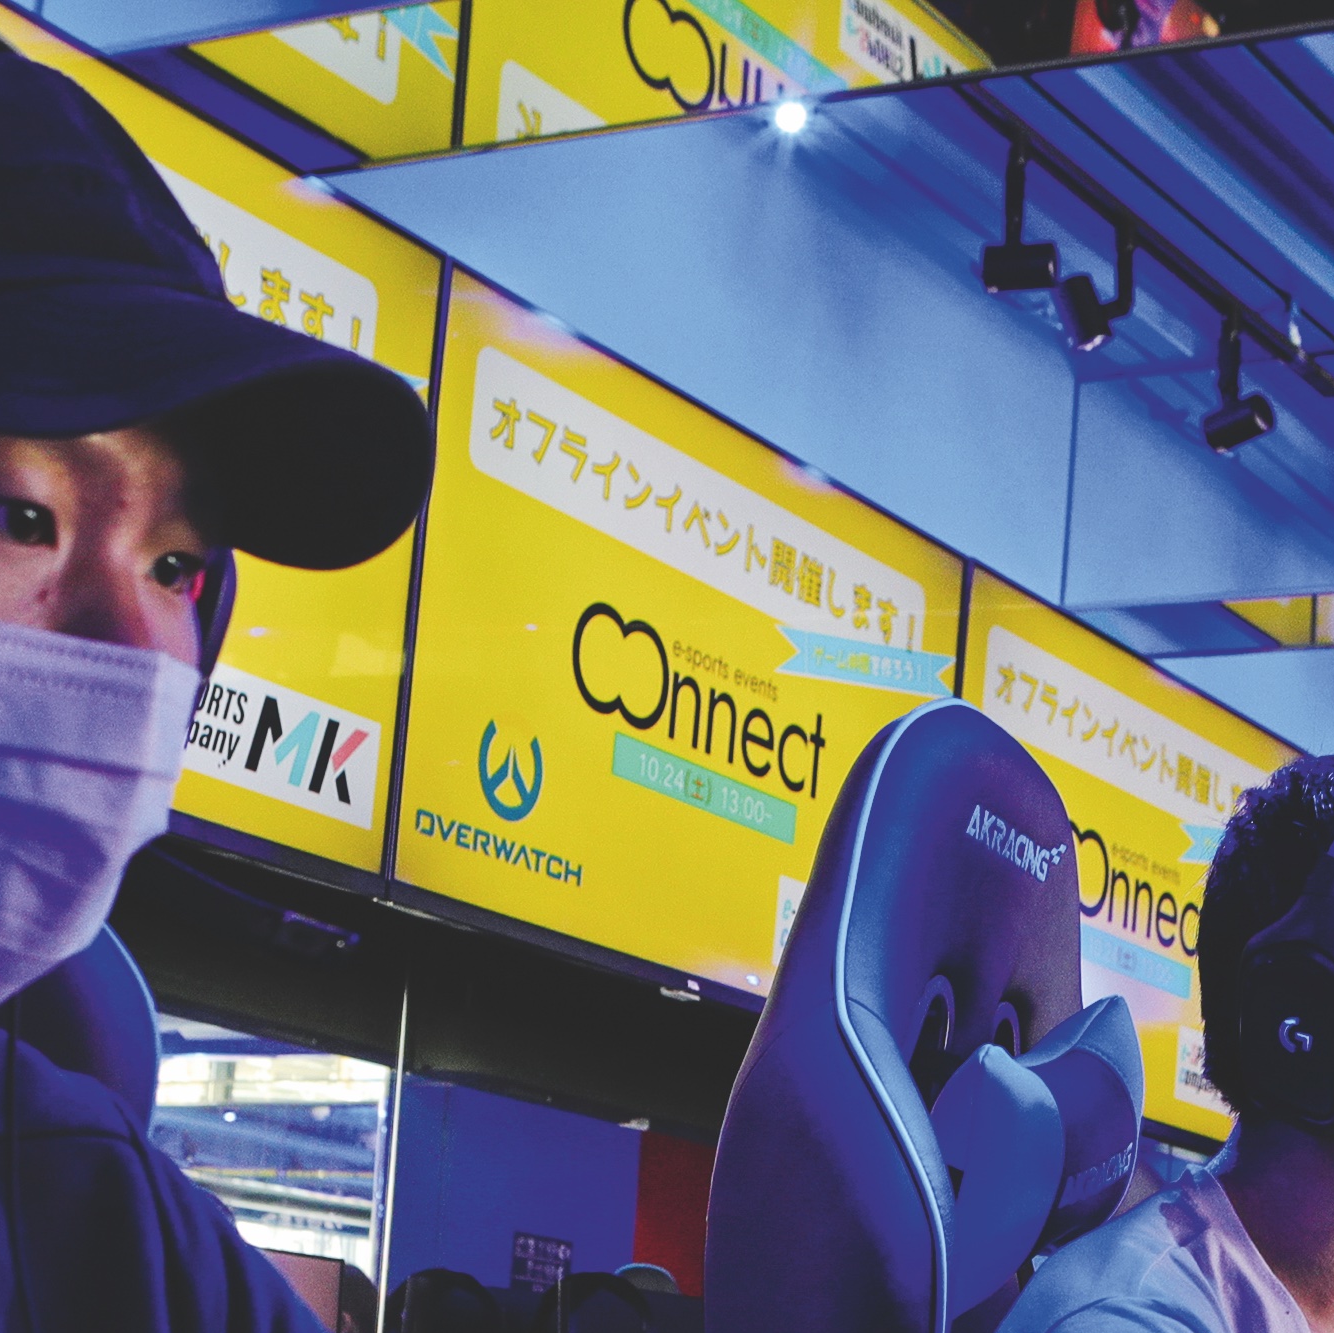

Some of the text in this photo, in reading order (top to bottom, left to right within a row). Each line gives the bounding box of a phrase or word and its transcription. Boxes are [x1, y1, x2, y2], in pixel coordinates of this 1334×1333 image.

[672, 639, 779, 702] e-sports events
[415, 807, 583, 887] OVERWATCH
[966, 804, 1050, 882] AKRACING
